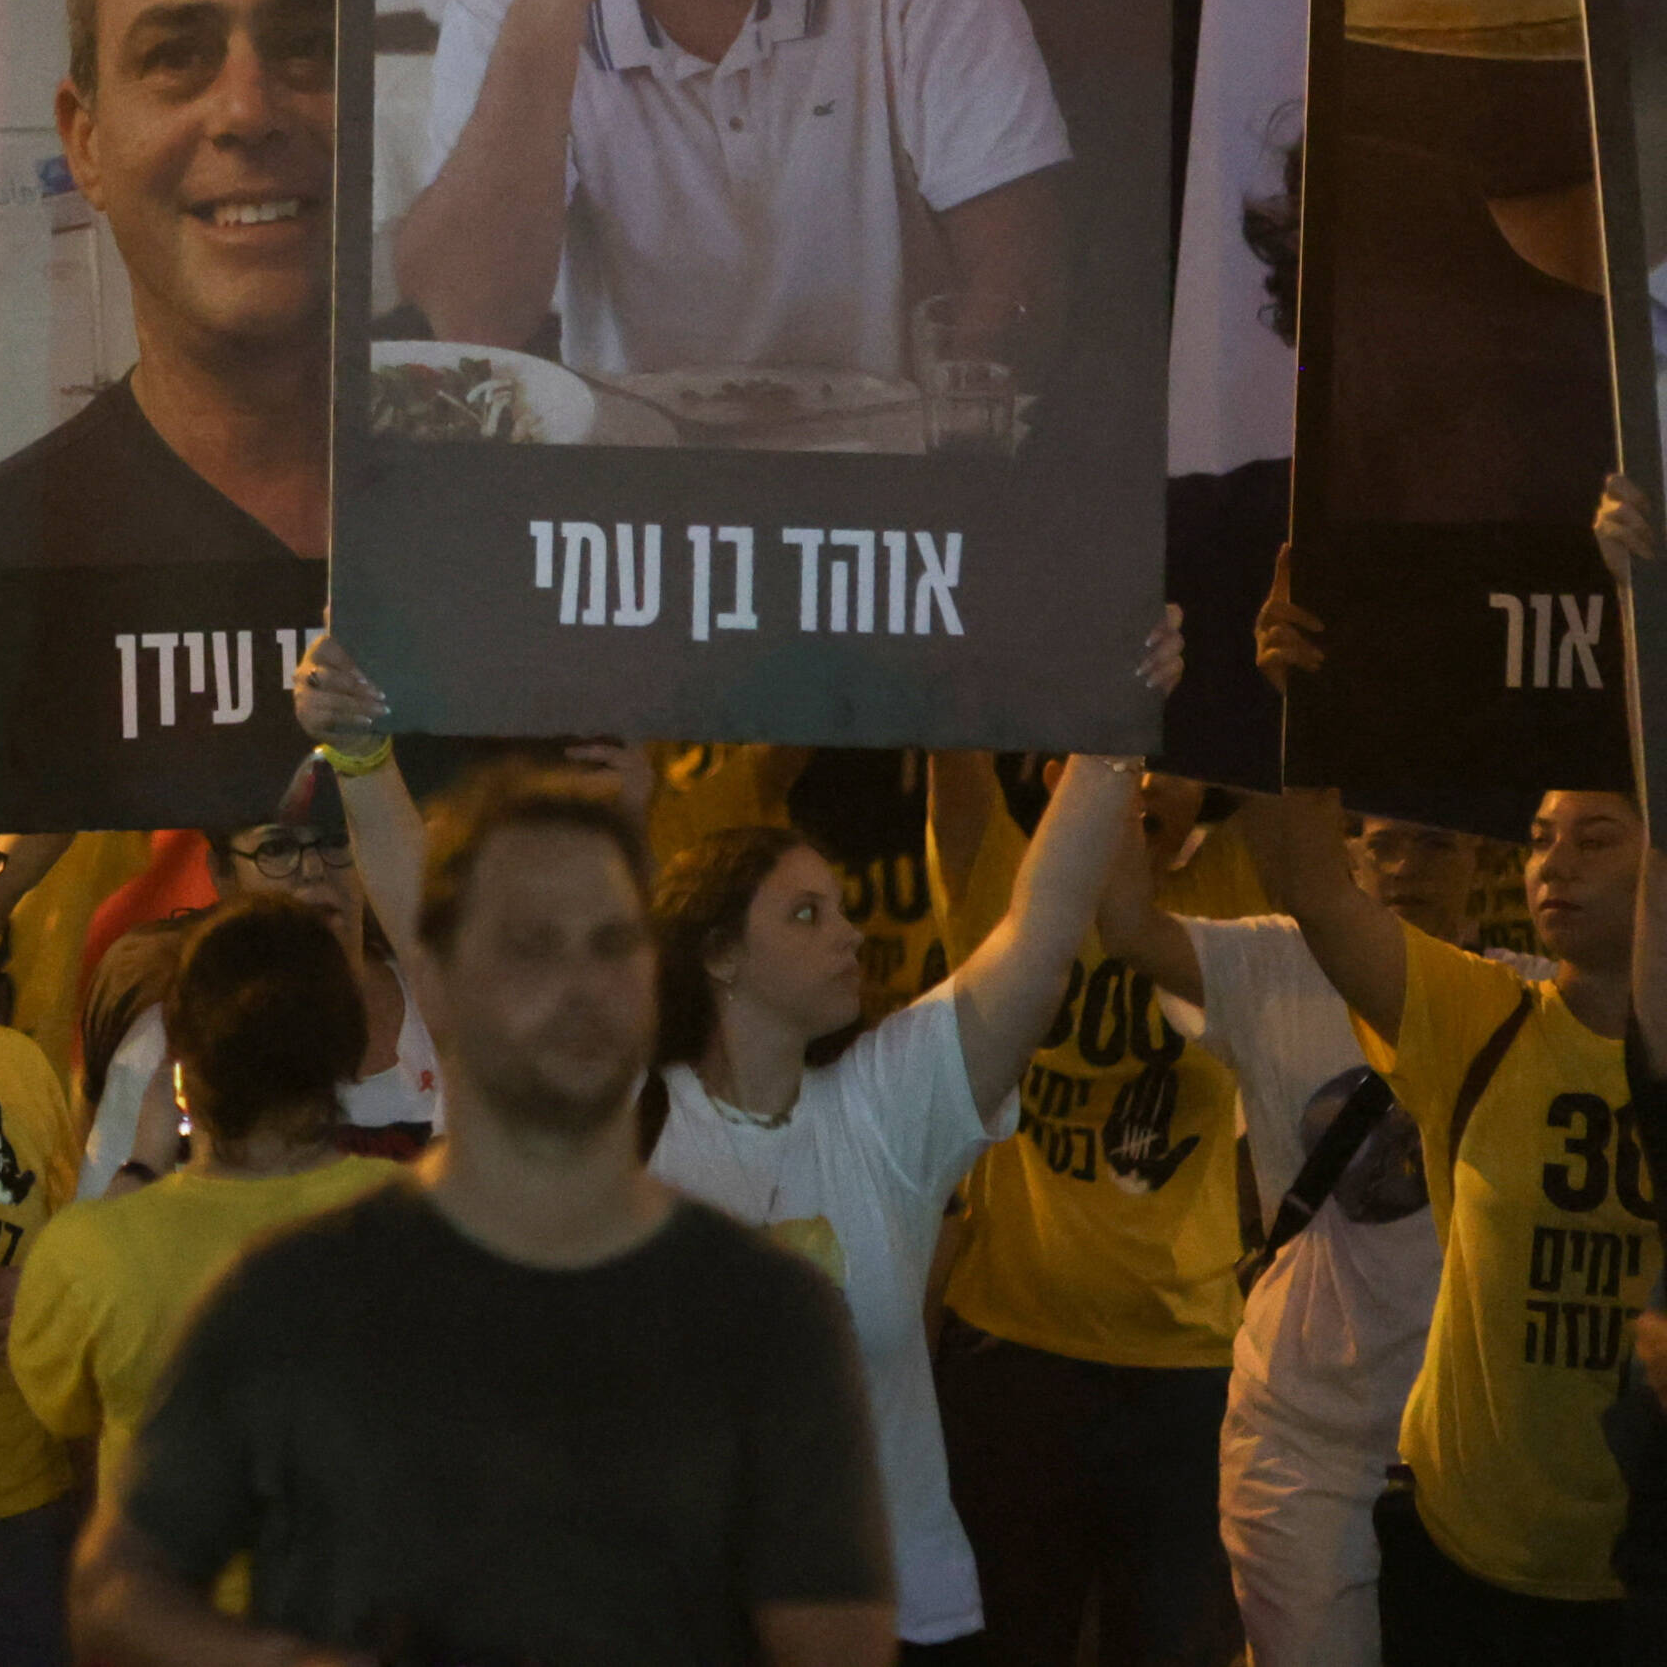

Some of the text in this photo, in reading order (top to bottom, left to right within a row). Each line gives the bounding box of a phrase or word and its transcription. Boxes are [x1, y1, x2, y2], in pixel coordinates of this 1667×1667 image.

[531, 520, 965, 642] אוהד בן עמי
[115, 632, 253, 739] עידן
[1489, 593, 1603, 689] אור
[1530, 1227, 1640, 1295] ימים
